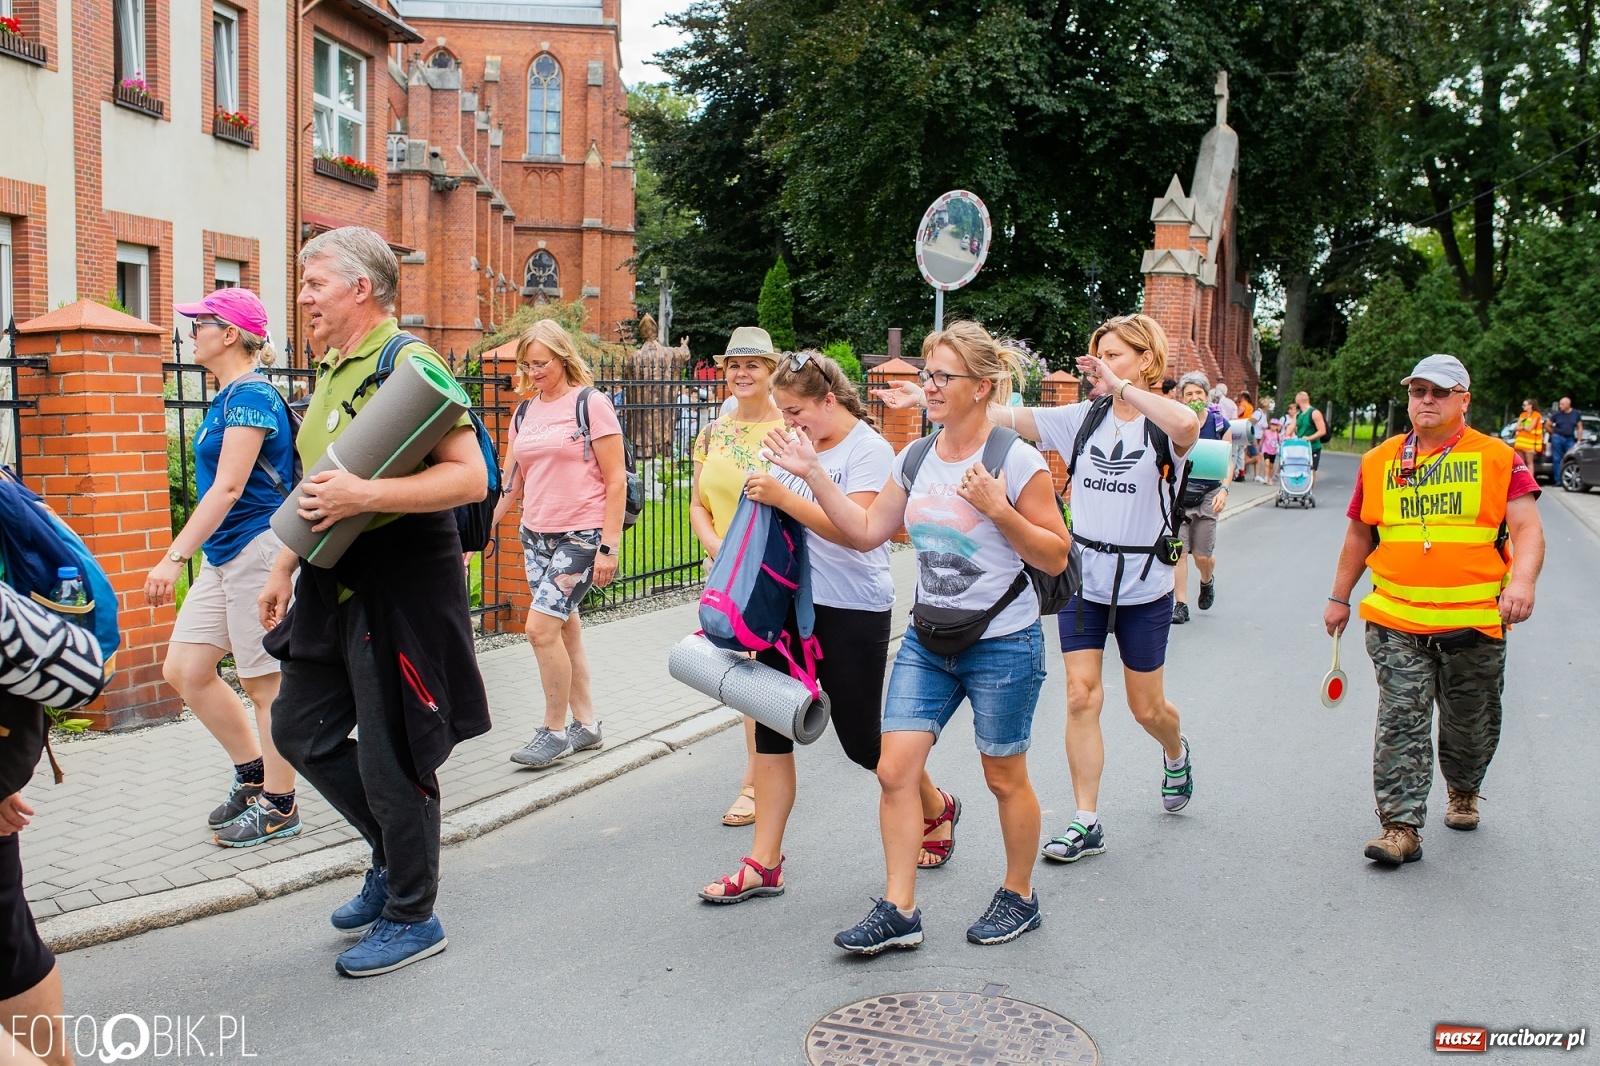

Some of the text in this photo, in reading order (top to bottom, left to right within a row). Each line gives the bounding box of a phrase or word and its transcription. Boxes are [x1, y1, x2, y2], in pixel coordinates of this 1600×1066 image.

[518, 424, 561, 434] CHOOSE
[516, 433, 550, 442] HAPPY
[1083, 477, 1137, 494] adidas
[1400, 491, 1462, 519] RUCHEM
